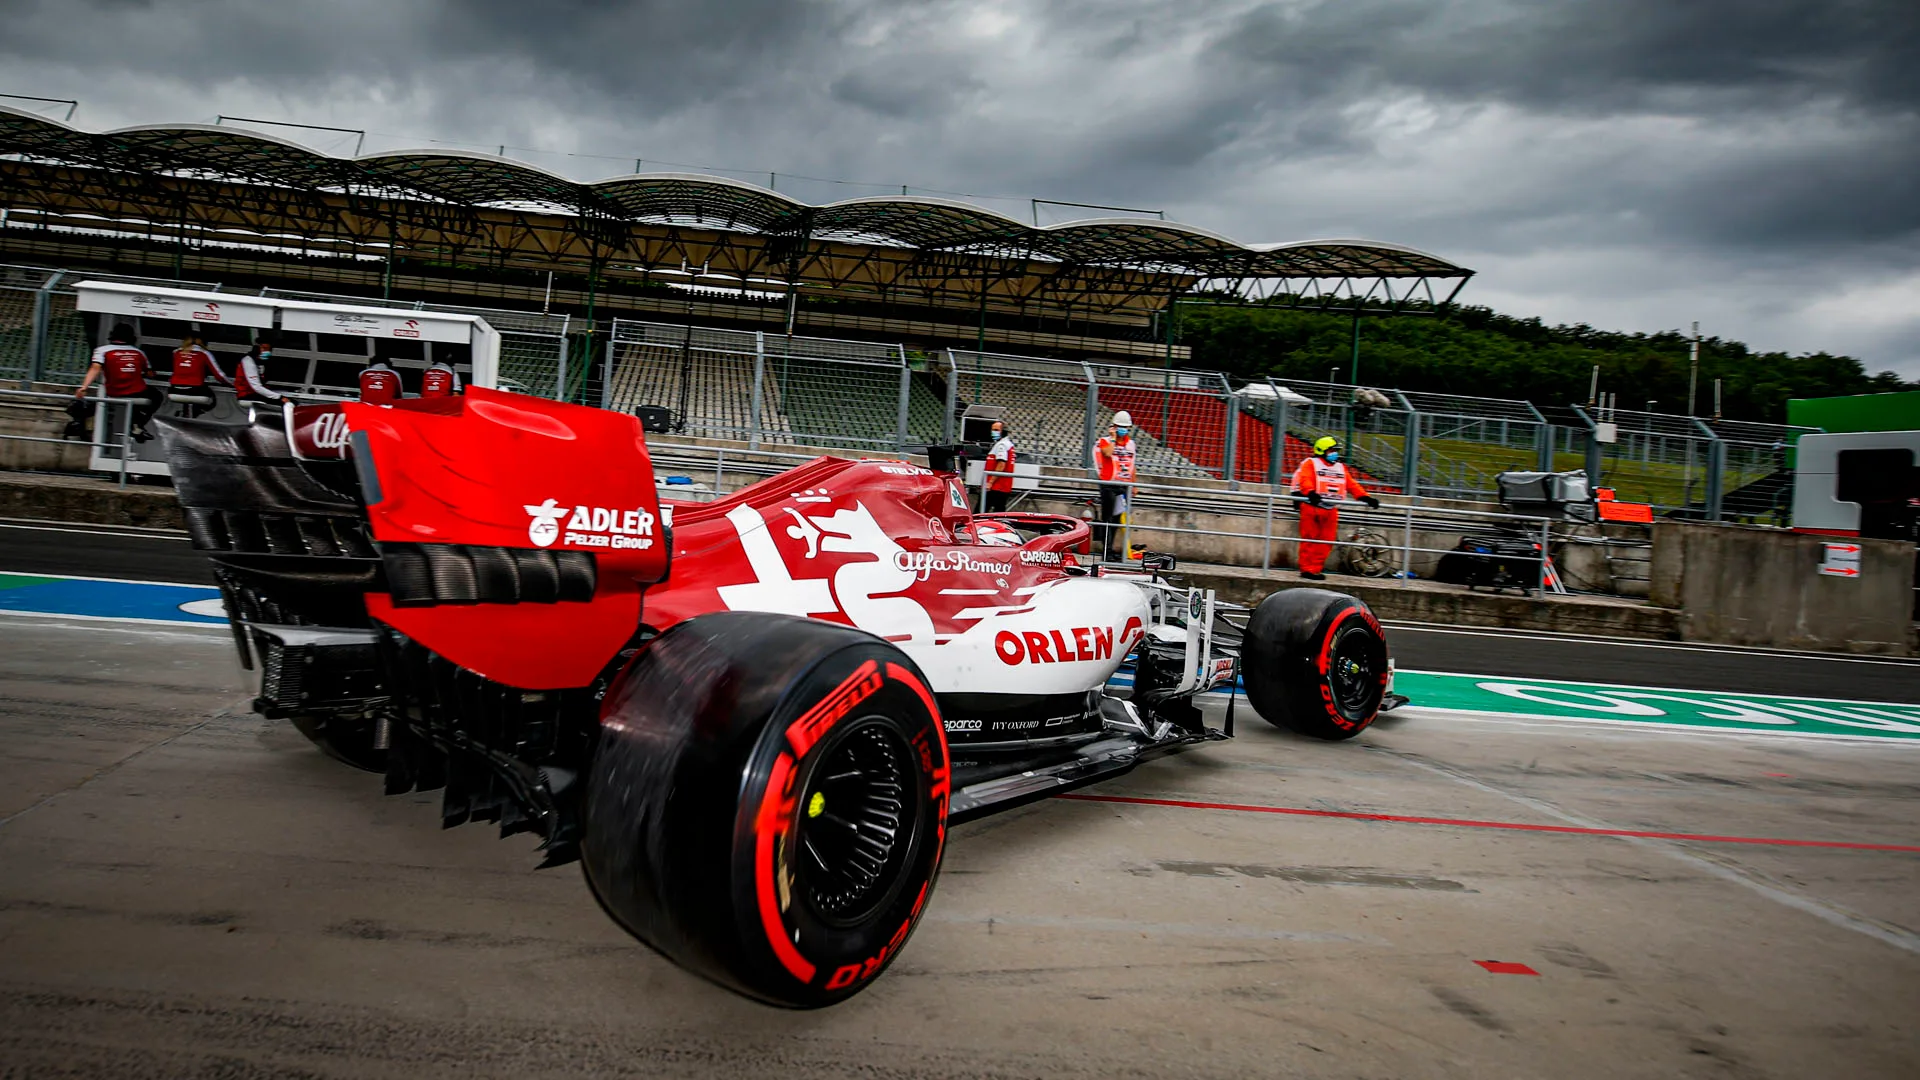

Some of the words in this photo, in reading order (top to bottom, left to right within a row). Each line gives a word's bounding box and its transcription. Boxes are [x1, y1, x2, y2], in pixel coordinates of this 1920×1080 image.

[313, 412, 352, 460] Alf
[879, 465, 935, 476] STELVIO
[566, 505, 655, 536] ADLER
[893, 550, 951, 582] Alfa
[948, 550, 1012, 576] Romeo
[1019, 550, 1061, 564] CARRERA
[994, 626, 1113, 666] ORLEN
[784, 659, 884, 760] PIRELLI
[992, 721, 1008, 730] IVY
[1007, 720, 1040, 730] OXFORD
[943, 719, 983, 732] sparco
